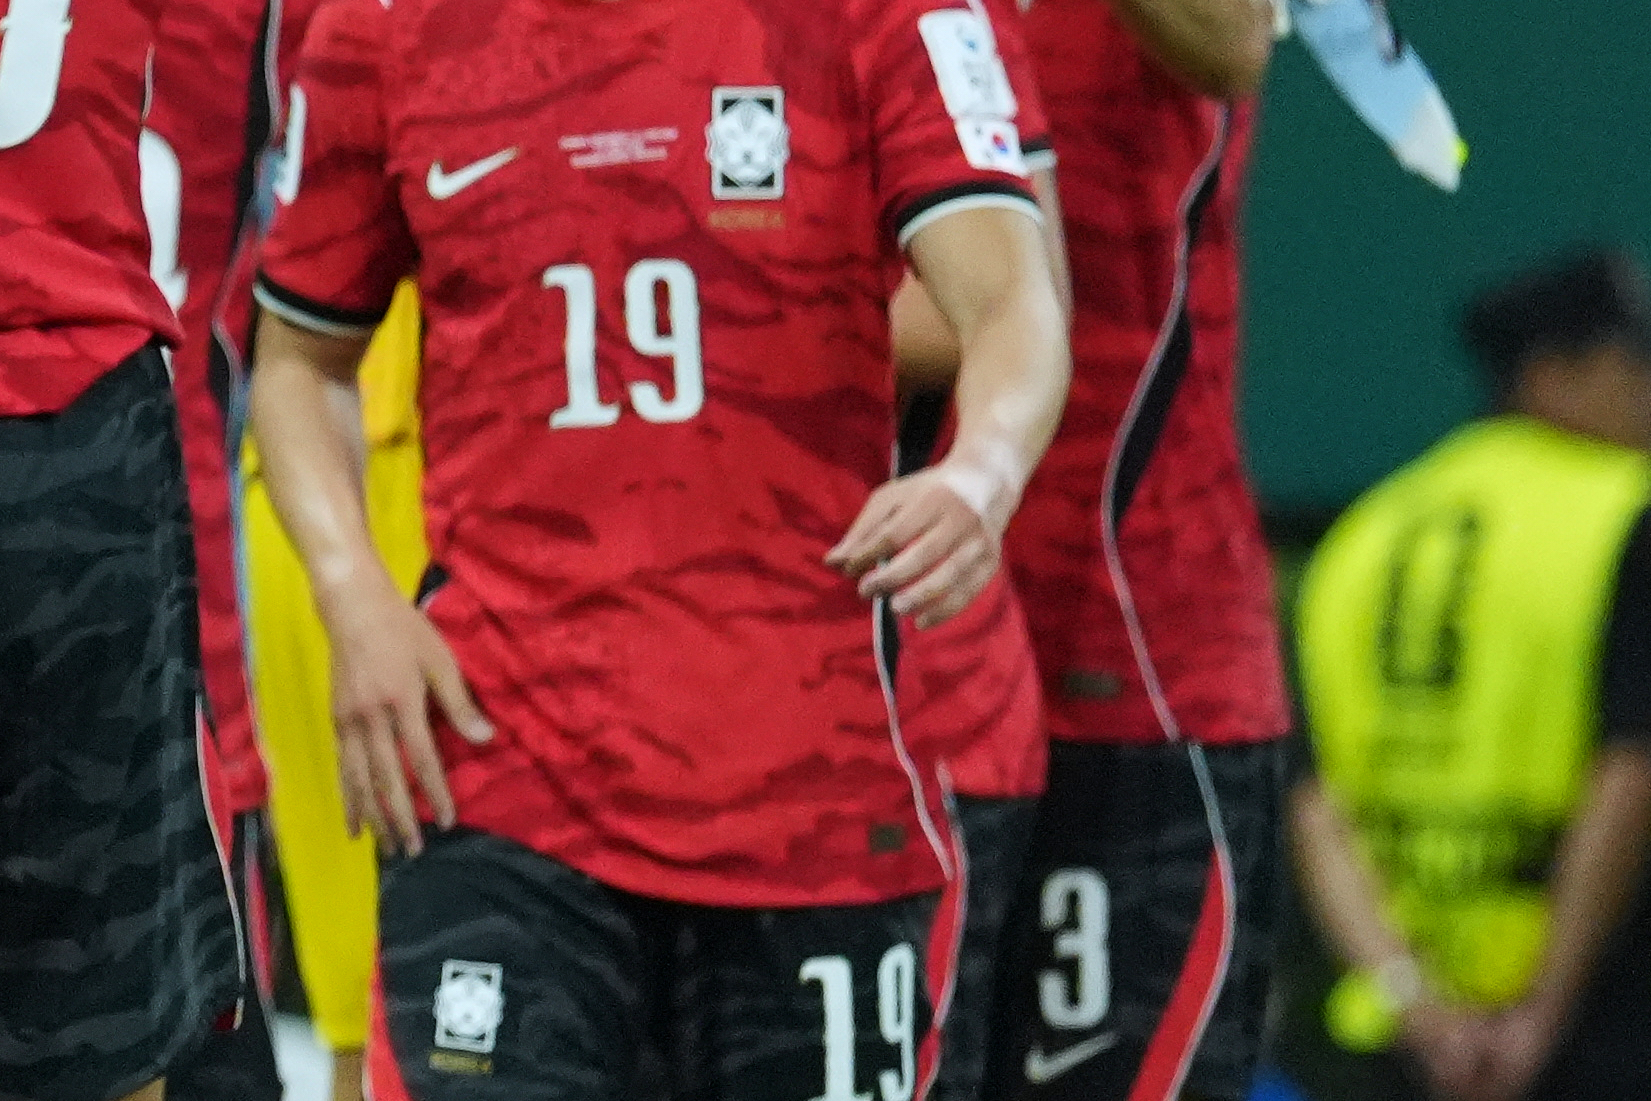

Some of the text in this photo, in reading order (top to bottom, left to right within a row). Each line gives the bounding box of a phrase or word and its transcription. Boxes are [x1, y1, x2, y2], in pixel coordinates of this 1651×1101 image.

[542, 257, 706, 430] 19
[799, 942, 917, 1101] 19
[1038, 866, 1112, 1030] 3
